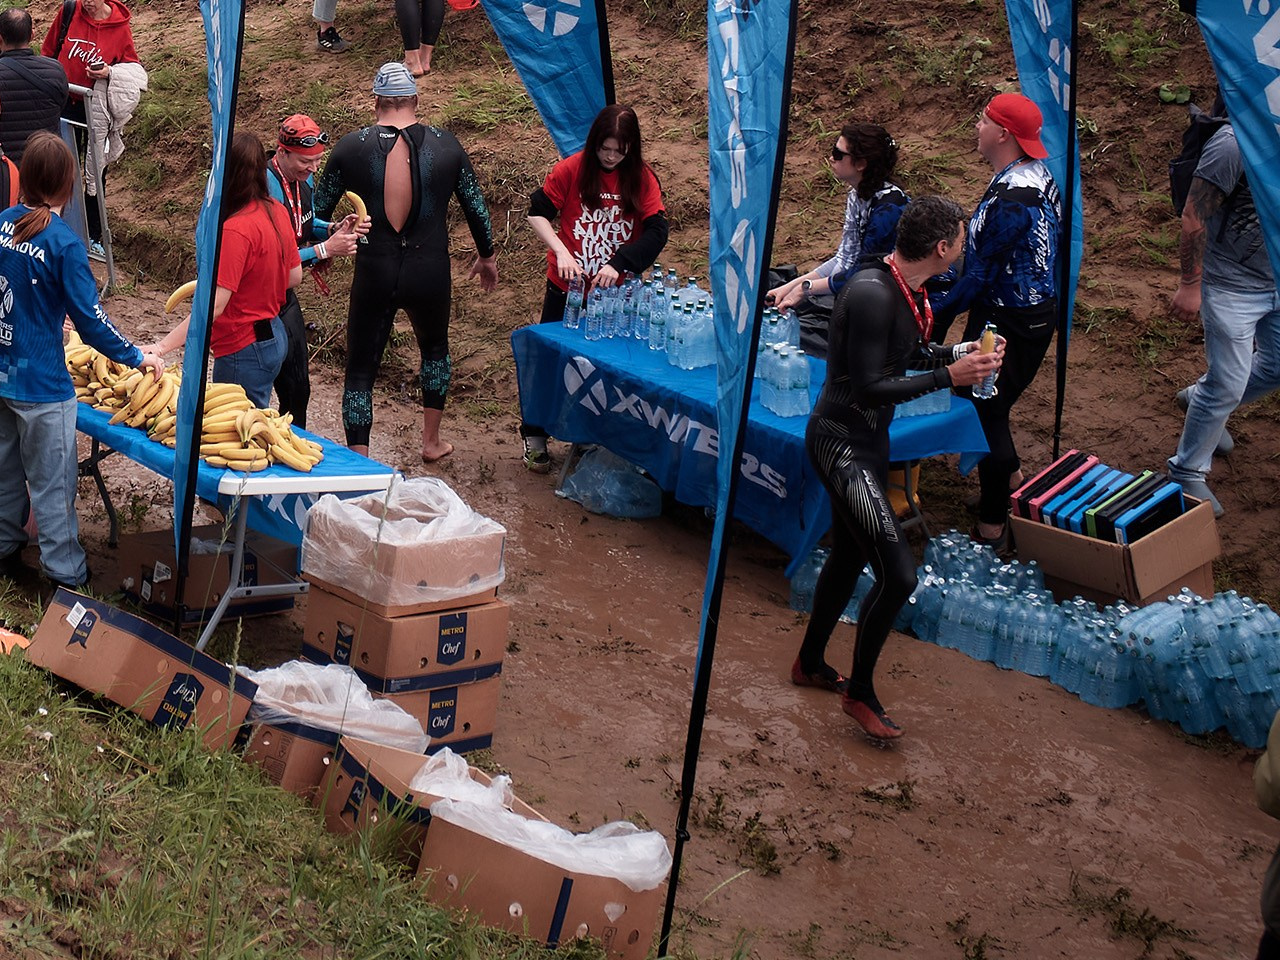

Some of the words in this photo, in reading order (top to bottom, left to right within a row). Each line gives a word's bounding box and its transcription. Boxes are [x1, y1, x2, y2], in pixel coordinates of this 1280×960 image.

[441, 626, 464, 636] METRO
[442, 642, 462, 656] Chef
[173, 683, 195, 702] Chef
[431, 699, 455, 709] METRO
[432, 715, 451, 729] Chef
